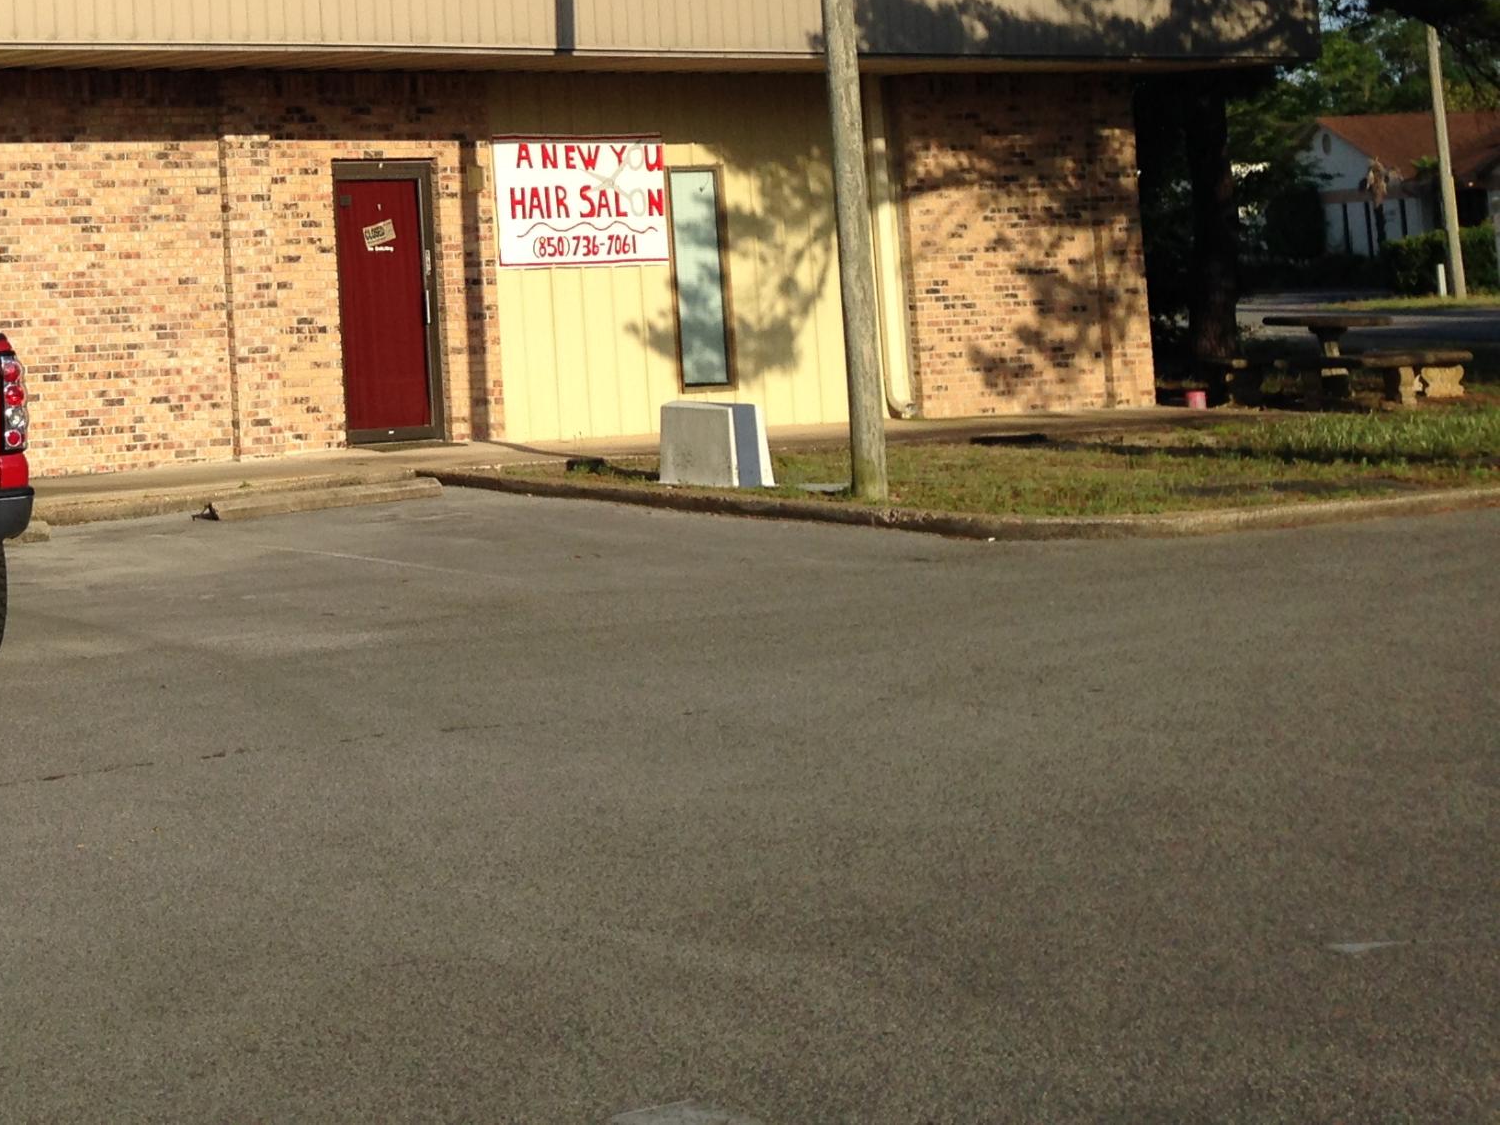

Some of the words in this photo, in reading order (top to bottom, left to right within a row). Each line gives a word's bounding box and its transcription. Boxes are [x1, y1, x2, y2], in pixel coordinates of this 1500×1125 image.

[516, 143, 533, 168] A
[541, 144, 600, 170] NEW
[610, 143, 664, 171] YOU
[510, 185, 570, 219] HAIR
[579, 185, 664, 218] SALON
